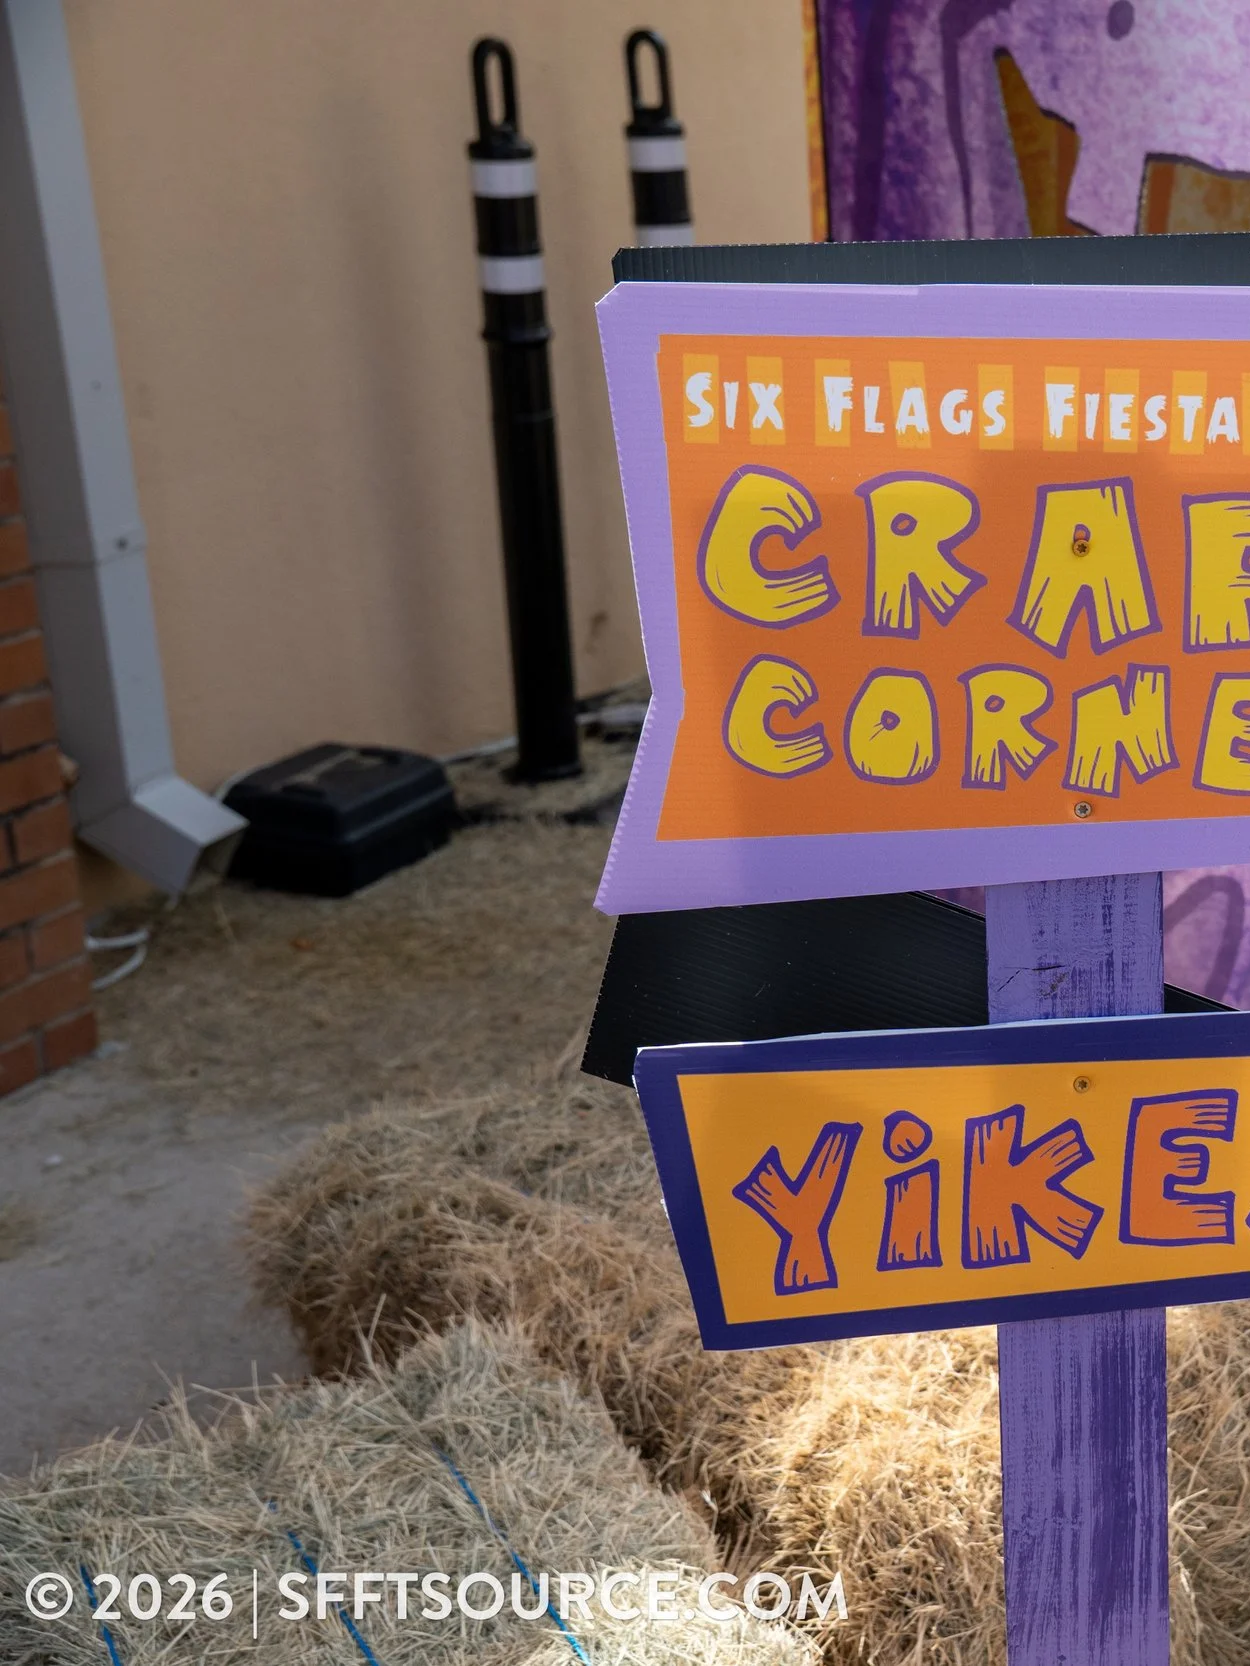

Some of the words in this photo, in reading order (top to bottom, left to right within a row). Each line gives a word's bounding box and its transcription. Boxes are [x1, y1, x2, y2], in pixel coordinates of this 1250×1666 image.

[685, 371, 784, 430] SIX
[823, 375, 1007, 439] FLAGS
[1046, 382, 1241, 444] FIESTA
